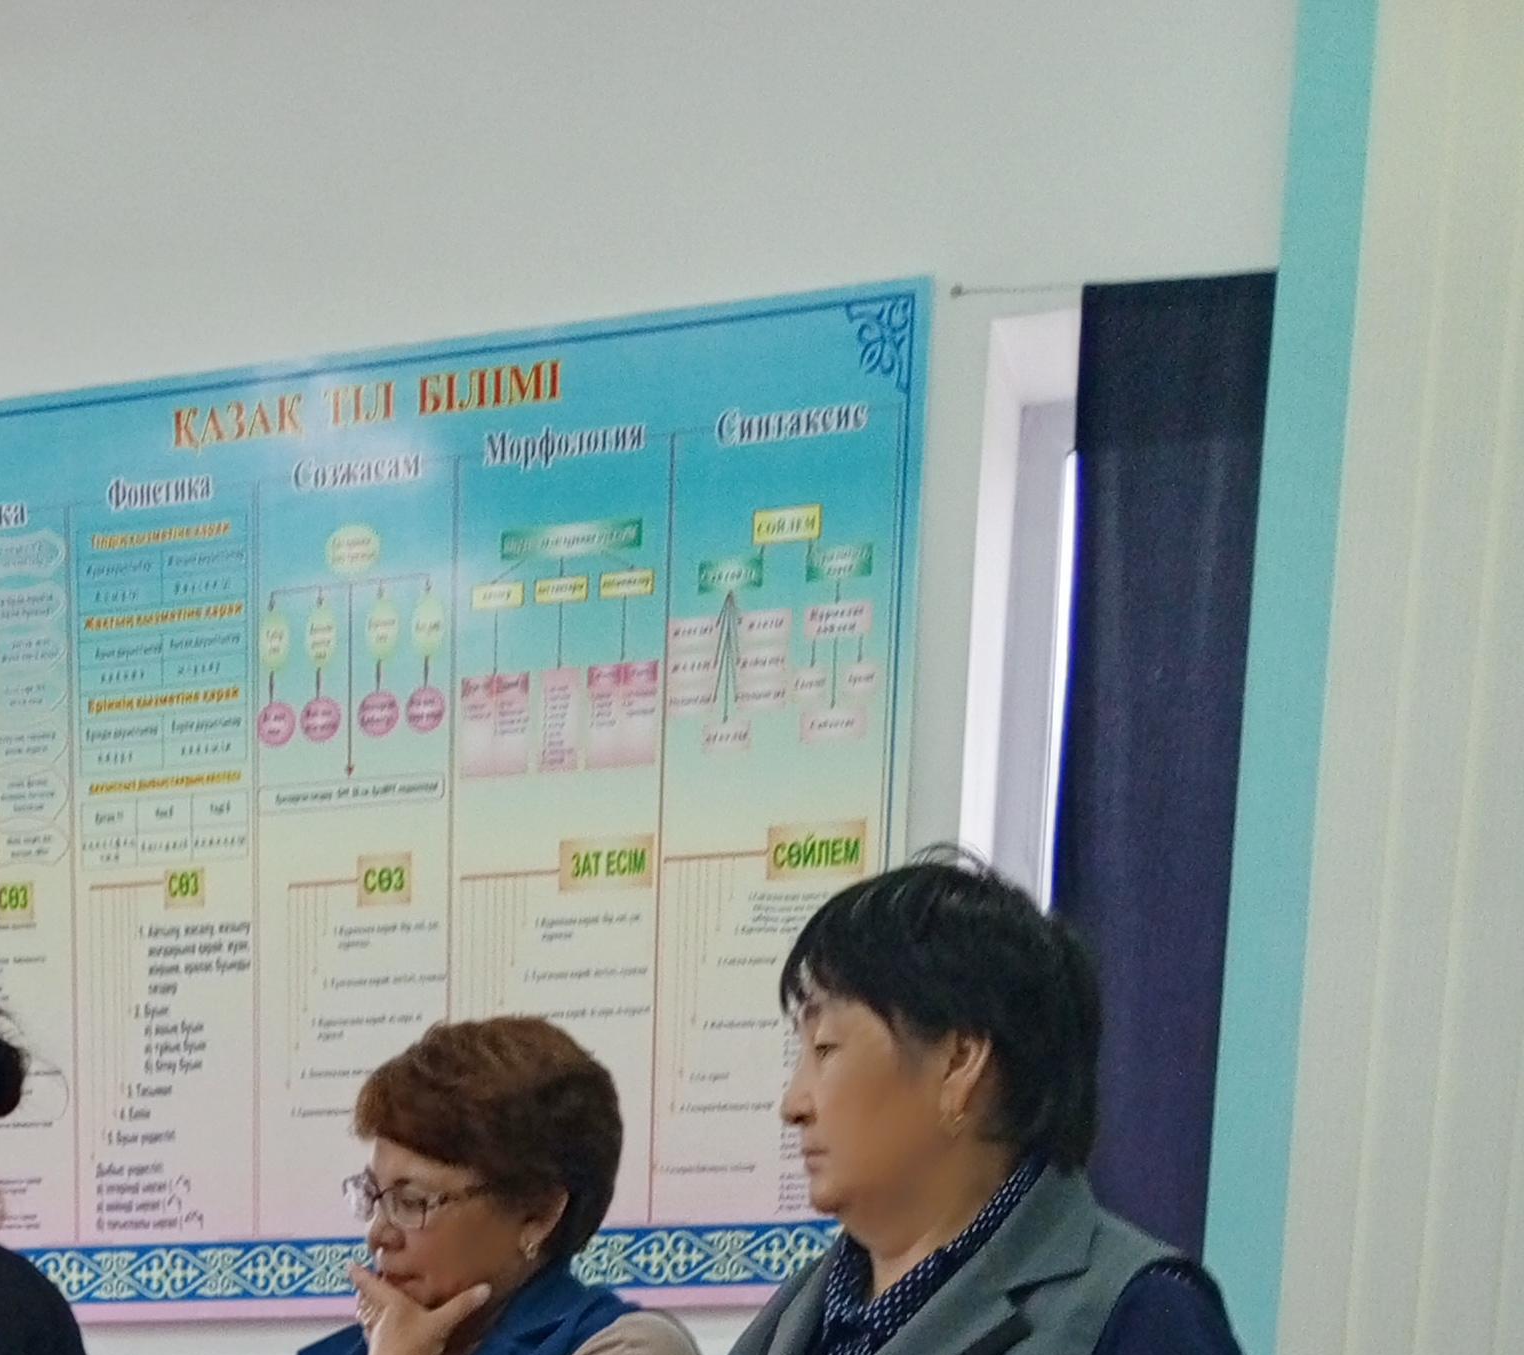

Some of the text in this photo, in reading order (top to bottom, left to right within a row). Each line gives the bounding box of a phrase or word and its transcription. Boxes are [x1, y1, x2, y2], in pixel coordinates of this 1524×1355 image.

[323, 382, 394, 427] ТІЛ
[418, 359, 563, 416] БІЛІМІ
[716, 402, 868, 447] Синтаксис
[484, 424, 646, 472] Морфология
[108, 475, 212, 511] Фонетика
[570, 847, 647, 879] ЗАТ ЕСІМ
[772, 831, 862, 871] СӨЙЛЕМ
[167, 871, 199, 898] СӨЗ
[363, 866, 406, 895] СӨЗ
